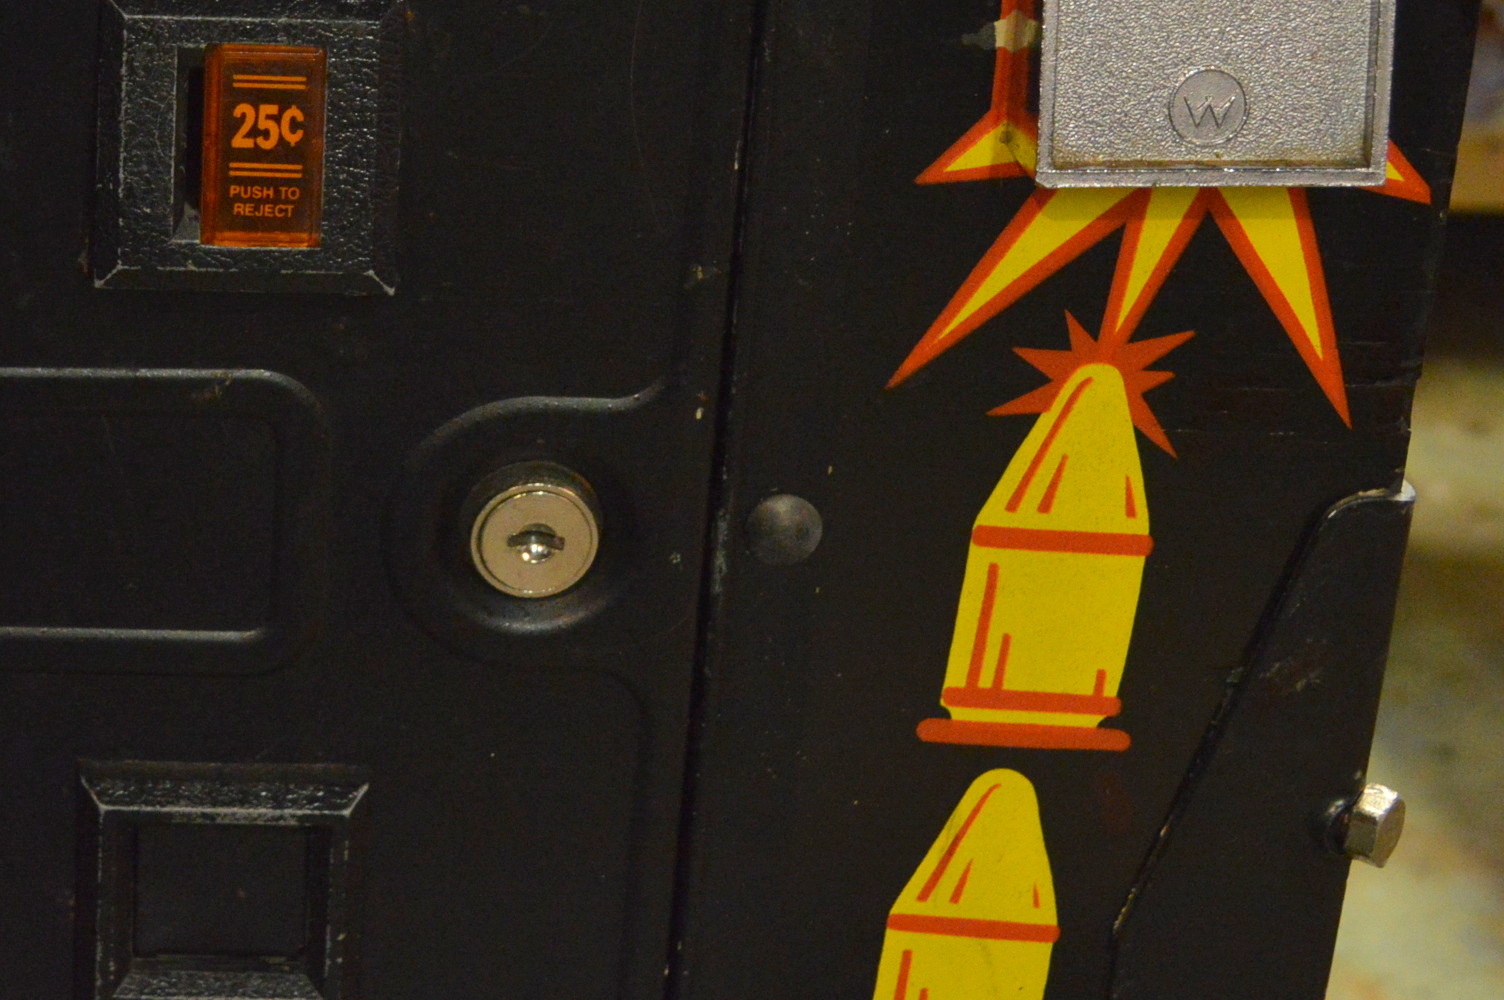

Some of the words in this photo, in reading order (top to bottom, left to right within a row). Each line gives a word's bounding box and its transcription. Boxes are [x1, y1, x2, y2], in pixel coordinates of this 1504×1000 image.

[231, 103, 305, 150] 25¢
[229, 185, 275, 200] PUSH
[279, 186, 301, 201] TO
[233, 203, 295, 218] REJECT
